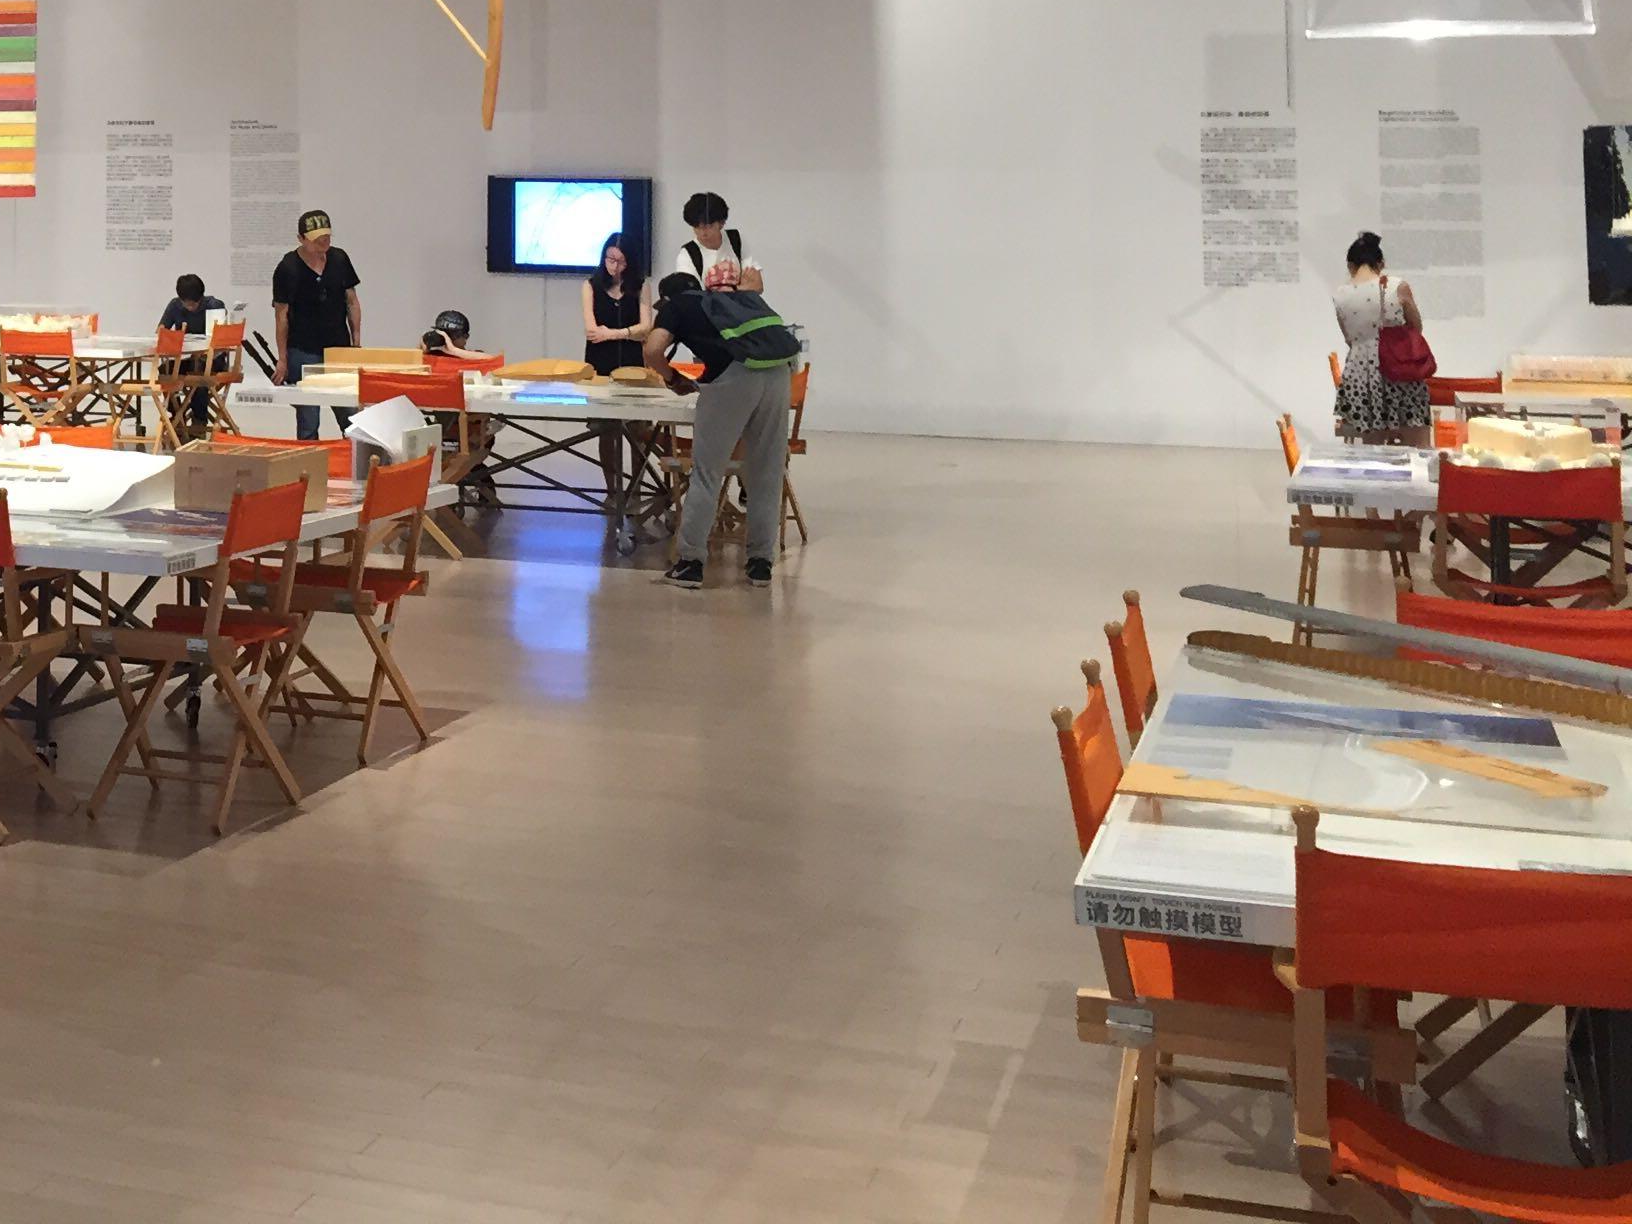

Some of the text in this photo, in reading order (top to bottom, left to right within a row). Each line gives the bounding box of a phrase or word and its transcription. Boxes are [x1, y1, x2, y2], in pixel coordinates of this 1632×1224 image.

[1086, 900, 1244, 938] 请勿触摸模型
